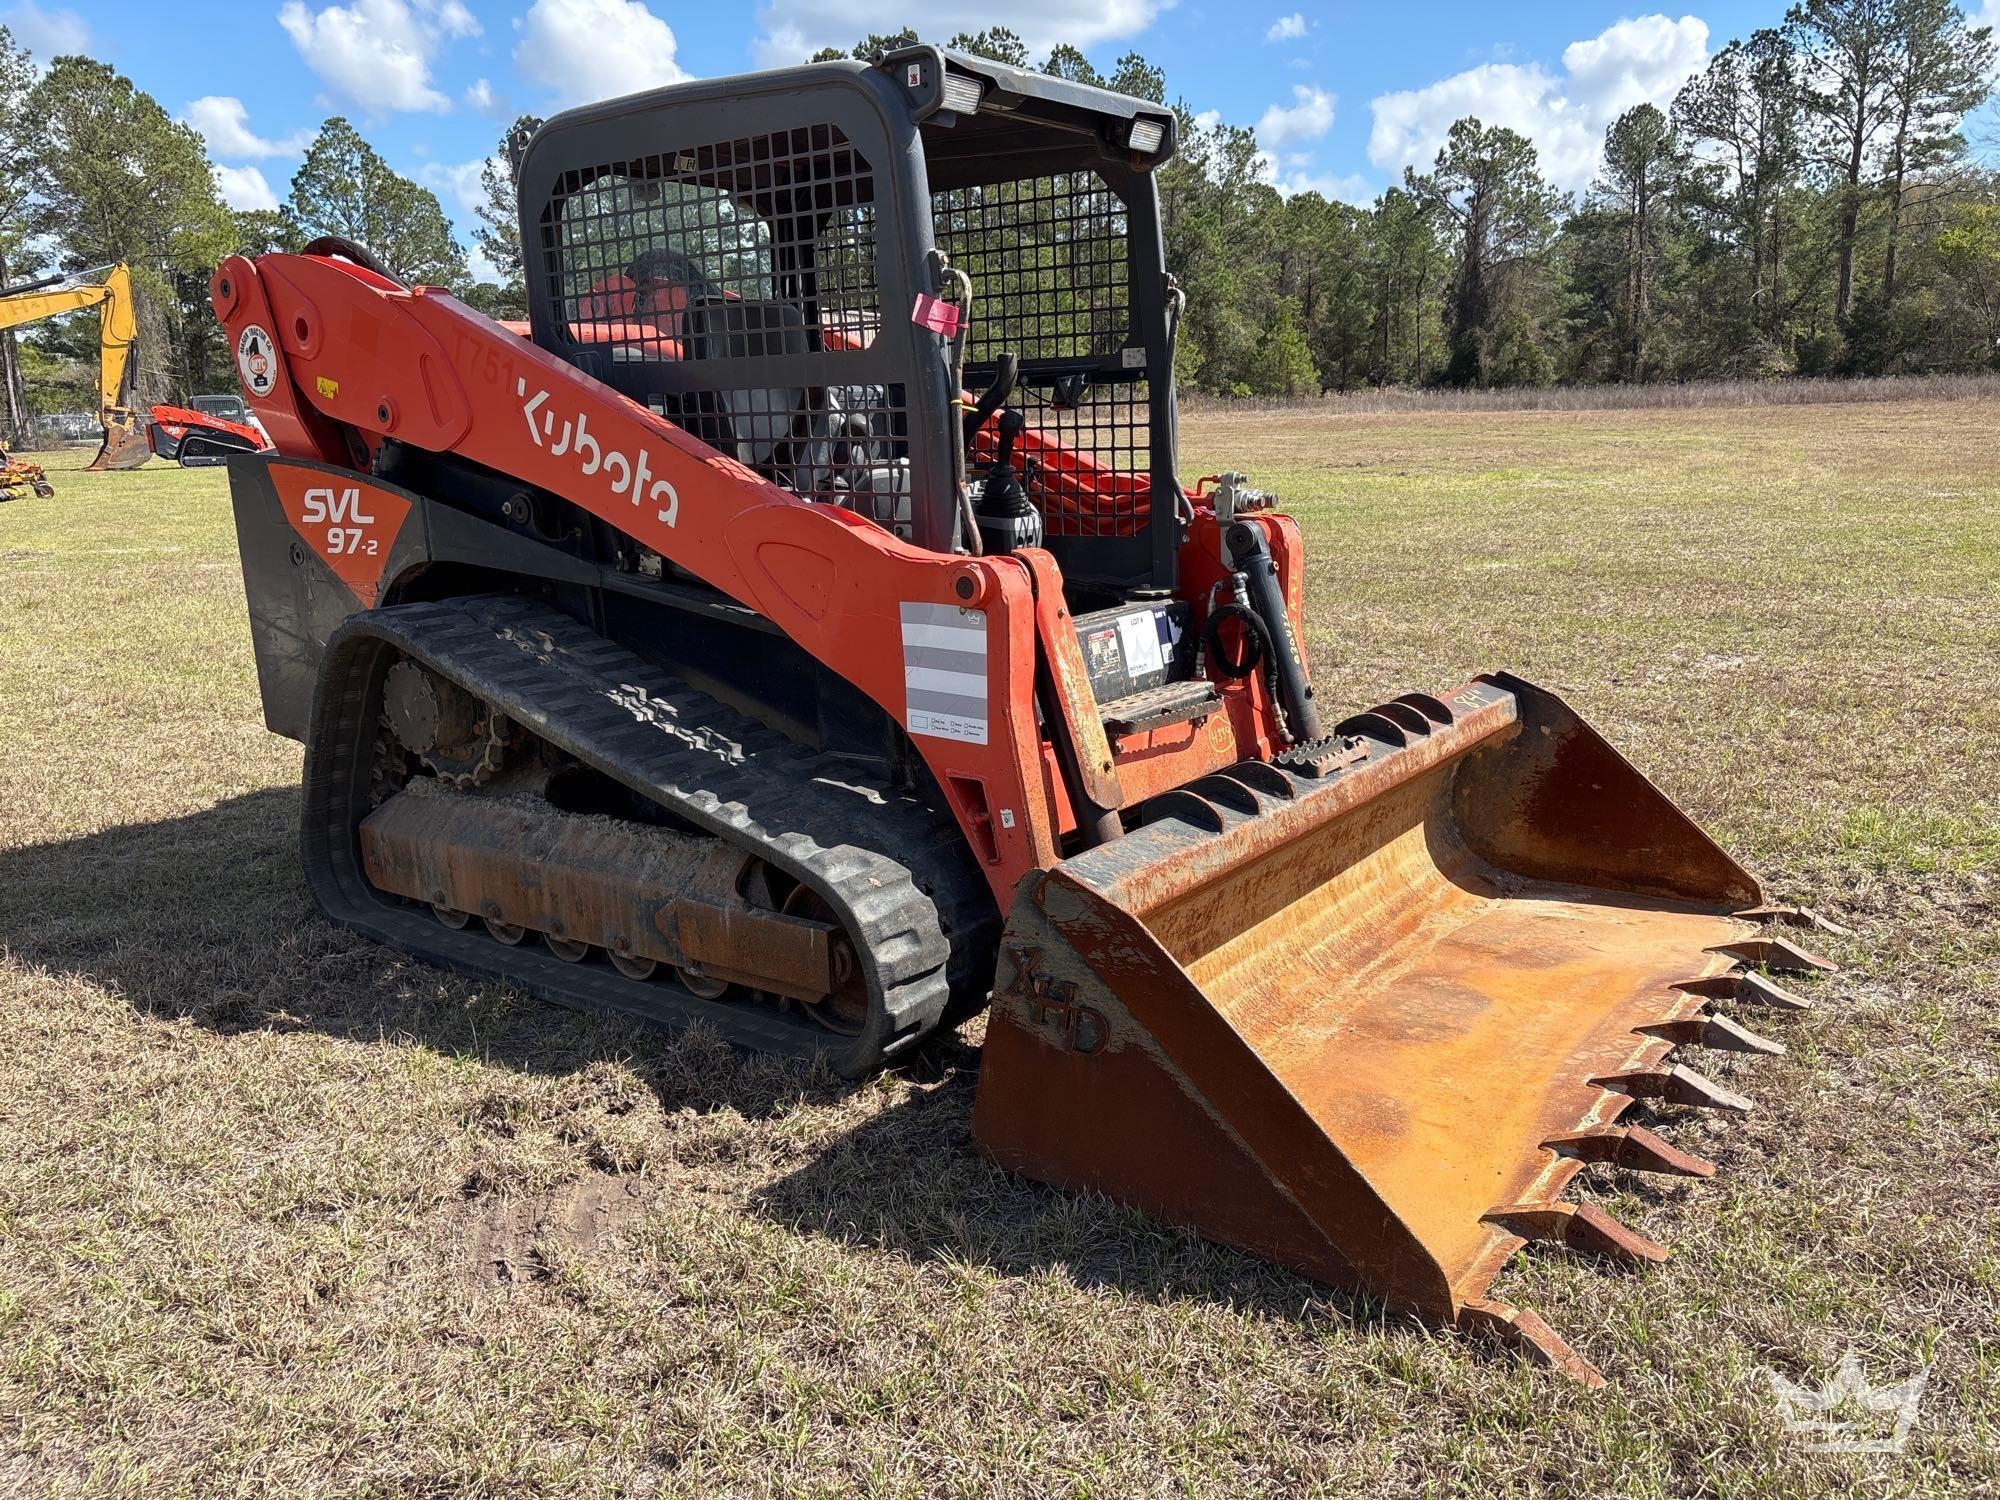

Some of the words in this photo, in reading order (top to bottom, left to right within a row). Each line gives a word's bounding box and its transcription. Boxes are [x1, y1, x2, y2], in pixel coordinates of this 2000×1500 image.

[517, 377, 679, 529] Kubota
[302, 488, 375, 524] SVL
[326, 527, 379, 556] 97-2
[1130, 617, 1140, 626] LOT
[1006, 945, 1112, 1057] XHD
